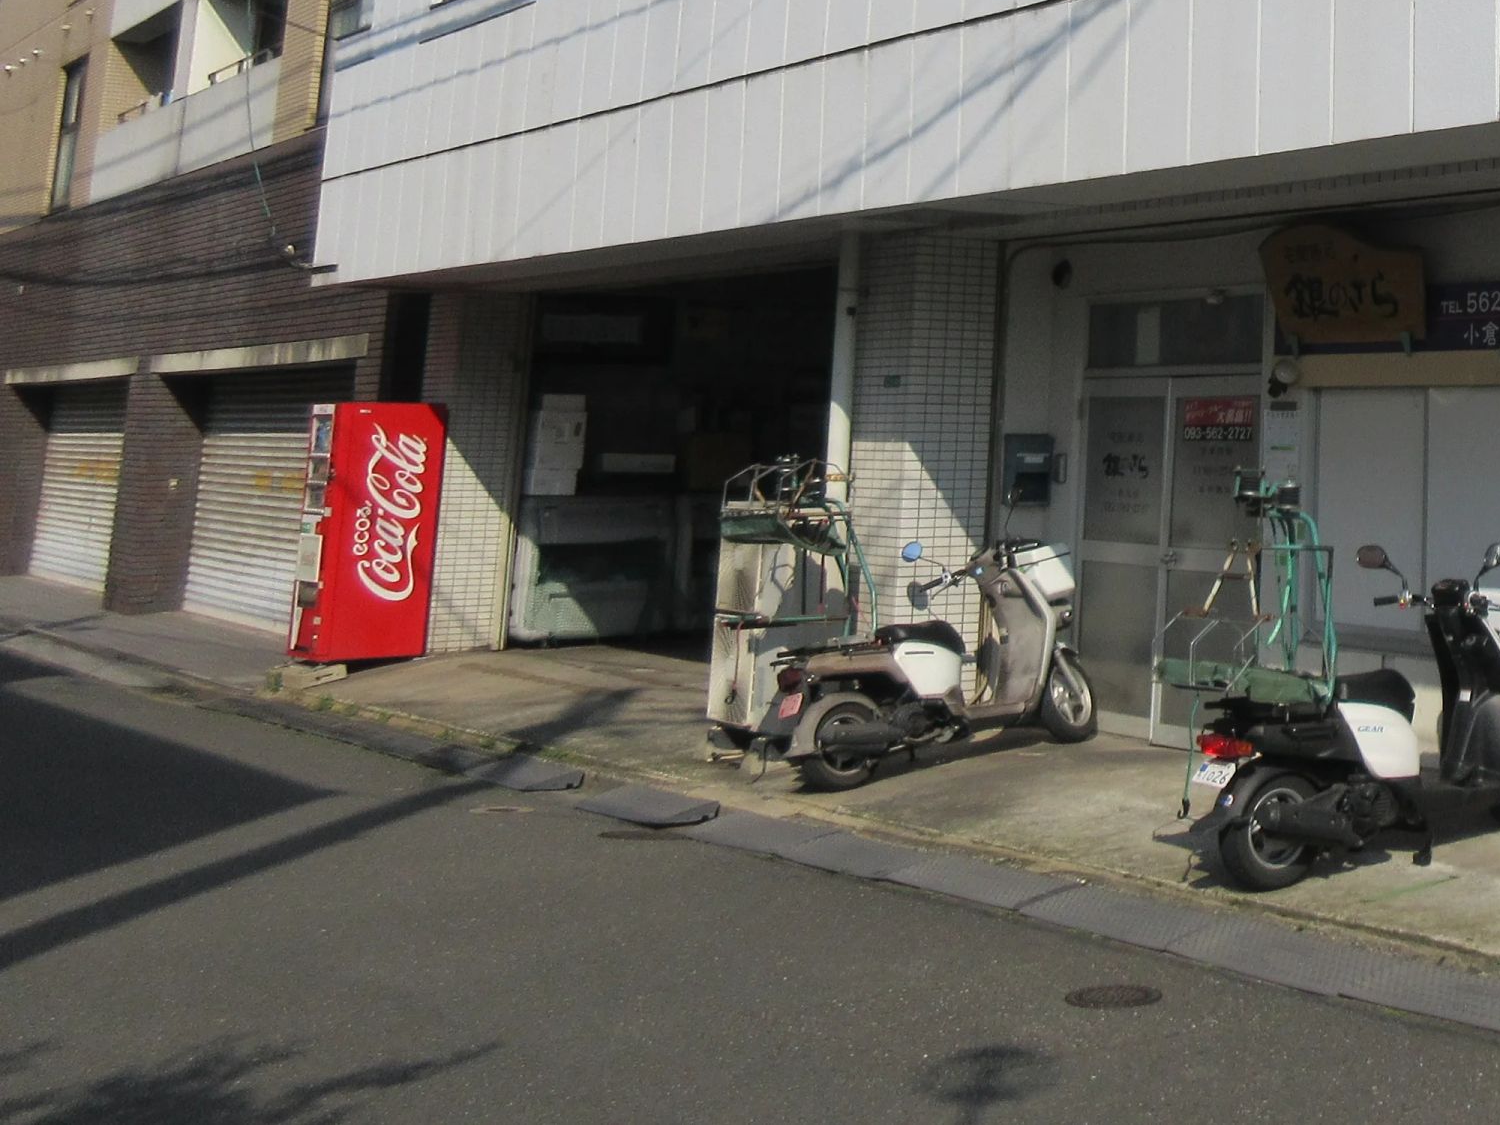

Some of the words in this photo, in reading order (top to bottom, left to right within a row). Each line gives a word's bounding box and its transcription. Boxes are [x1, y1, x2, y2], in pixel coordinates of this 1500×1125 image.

[1440, 300, 1462, 315] TEL
[1184, 426, 1253, 440] 093-562-2727
[357, 422, 429, 602] Coca-Cola
[1357, 725, 1385, 733] GEAR
